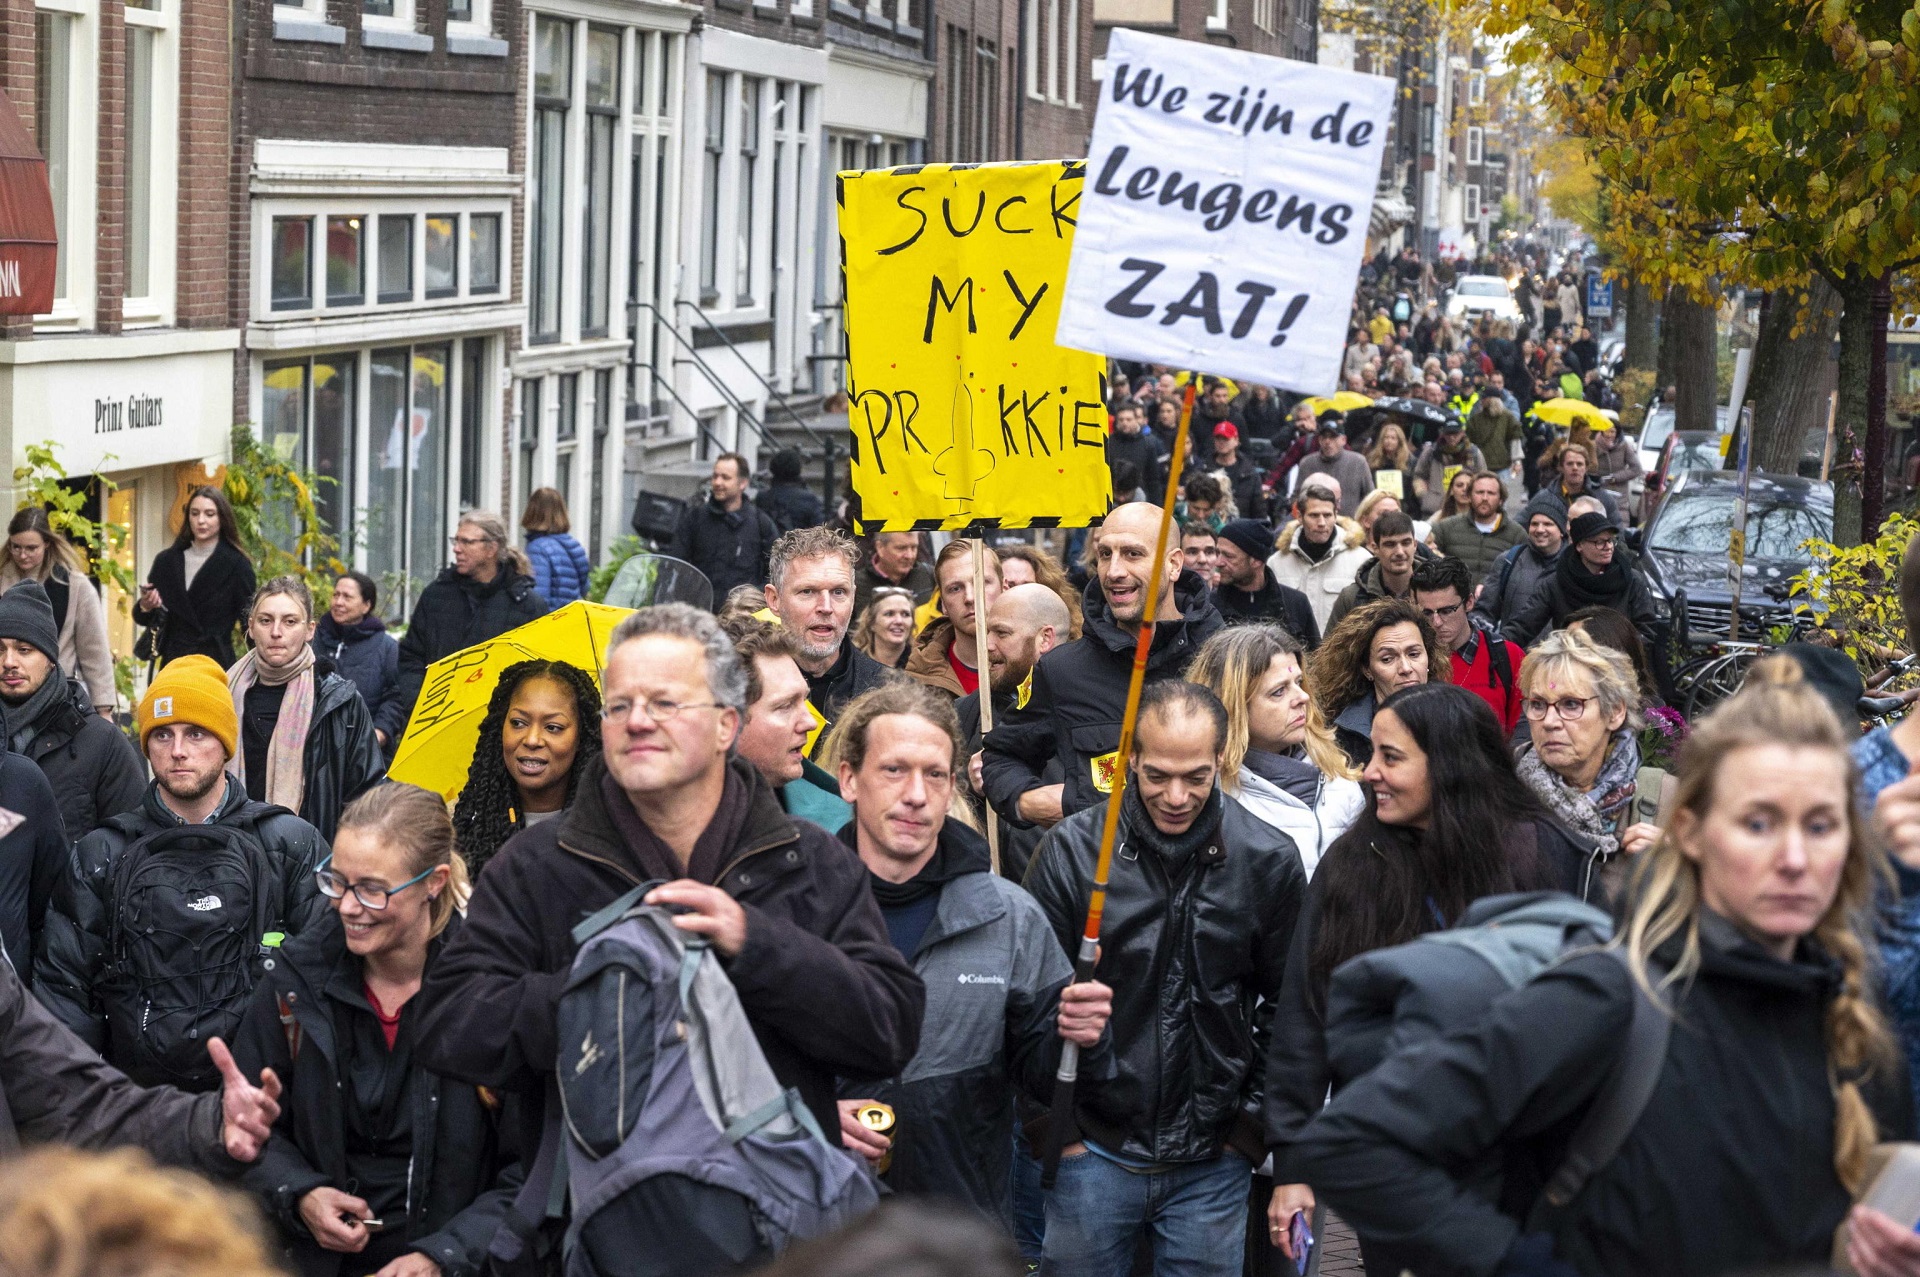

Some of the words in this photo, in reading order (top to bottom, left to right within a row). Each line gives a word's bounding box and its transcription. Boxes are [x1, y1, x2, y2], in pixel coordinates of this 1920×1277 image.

[1113, 63, 1188, 112] We
[1203, 86, 1294, 136] zijn
[1310, 102, 1374, 147] de
[875, 184, 1083, 256] SUCK
[923, 269, 1049, 344] MY
[1105, 257, 1310, 347] ZAT!
[94, 396, 123, 434] Prinz
[128, 392, 163, 429] Guitars
